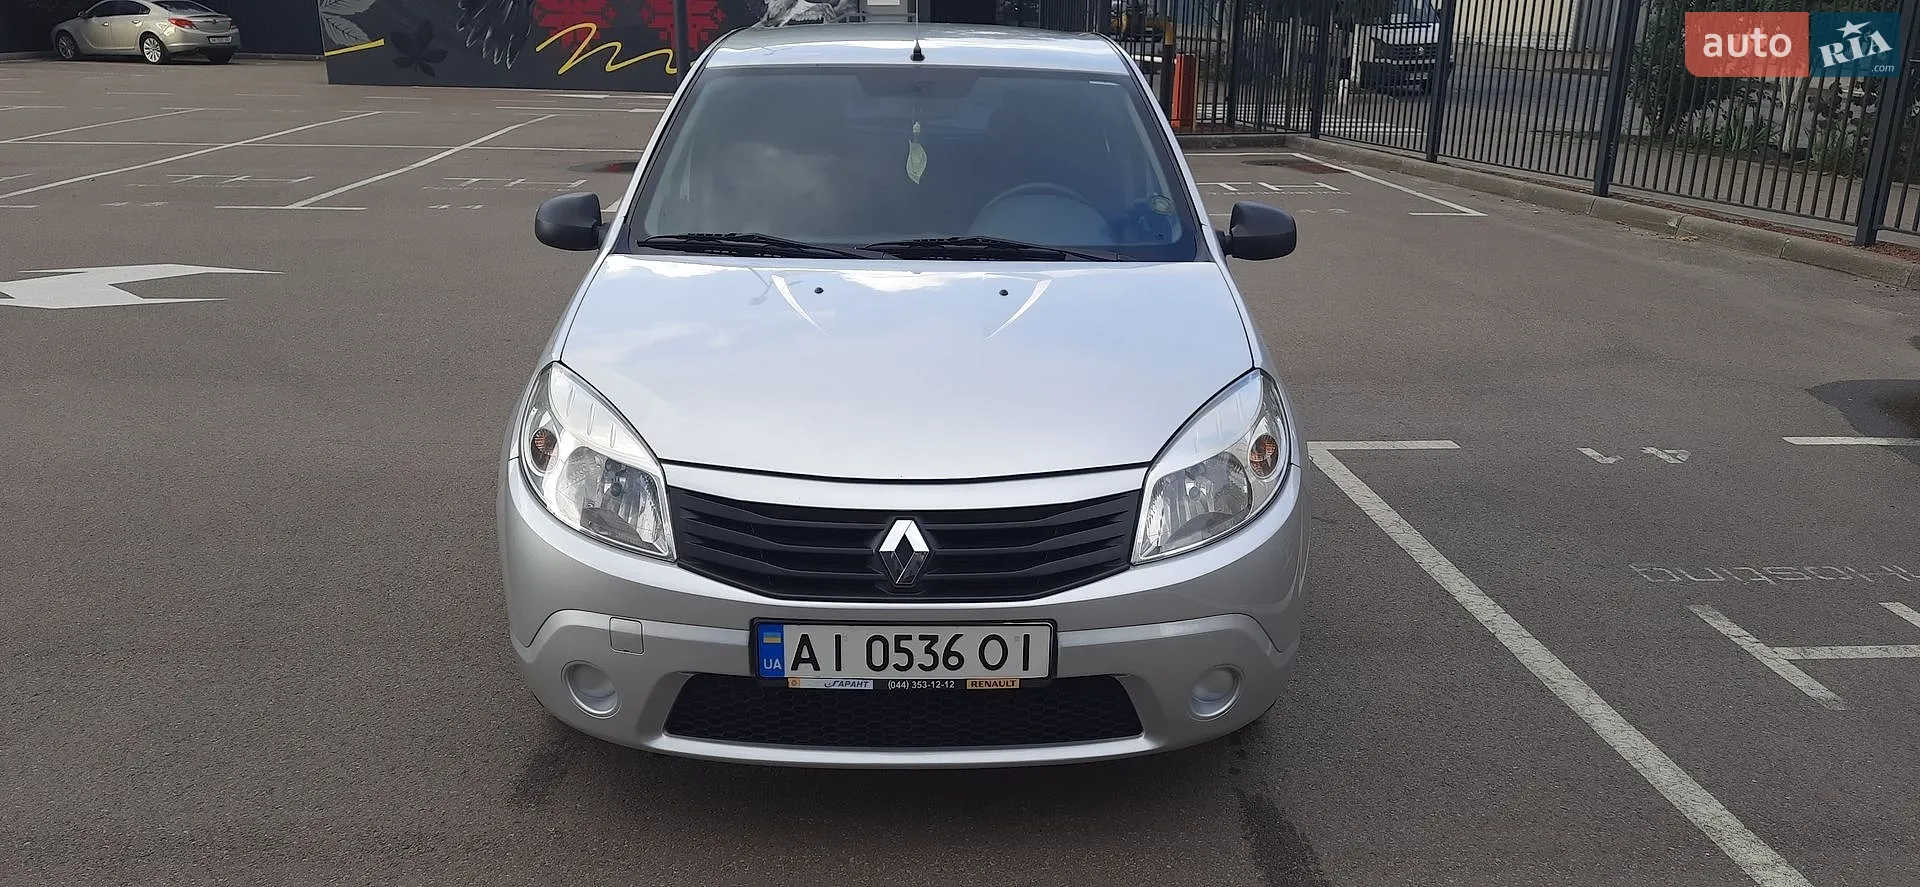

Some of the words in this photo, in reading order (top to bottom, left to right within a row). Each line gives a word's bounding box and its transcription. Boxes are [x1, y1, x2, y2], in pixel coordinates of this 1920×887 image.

[763, 658, 782, 671] UA
[790, 634, 842, 672] AI
[865, 634, 965, 672] 0536
[978, 634, 1031, 672] OI
[828, 680, 868, 689] ГАРАНТ
[888, 680, 909, 690] (044)
[911, 680, 955, 690] 353-12-12
[970, 679, 1016, 689] RENAULT
